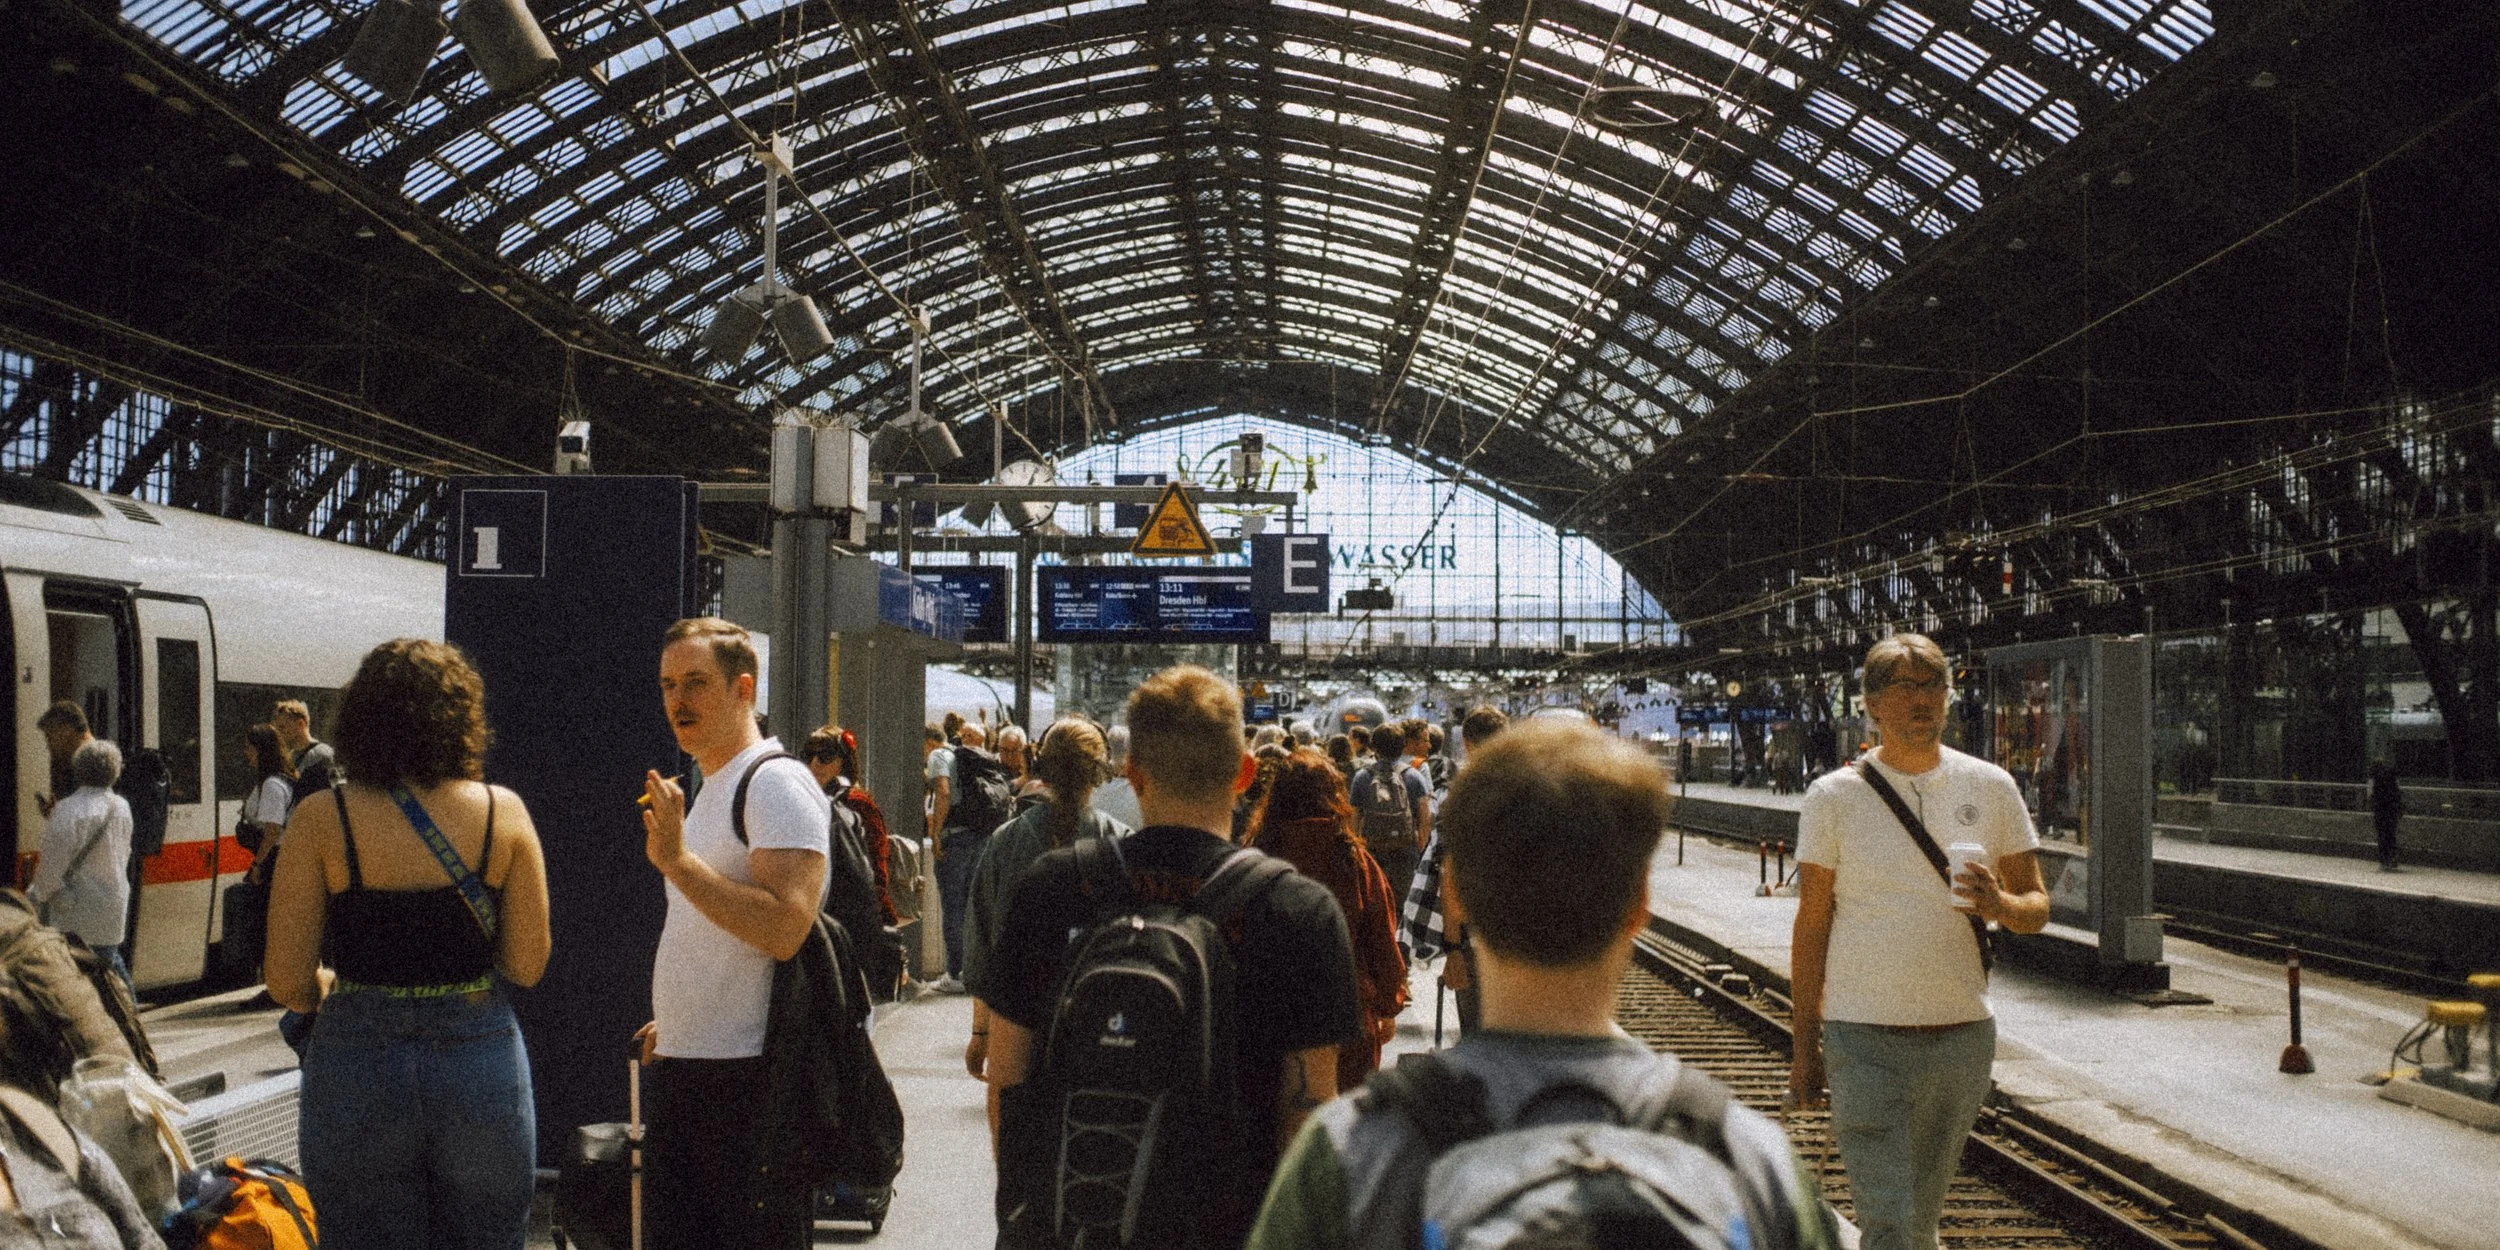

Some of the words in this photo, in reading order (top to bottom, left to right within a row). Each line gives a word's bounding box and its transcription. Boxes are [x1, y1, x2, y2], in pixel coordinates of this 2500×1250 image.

[1206, 458, 1280, 492] 41
[472, 526, 502, 569] 1
[1328, 544, 1457, 569] WASSER
[1283, 537, 1318, 593] E
[1159, 583, 1183, 593] 13:11
[1159, 595, 1191, 605] Dresden
[1192, 595, 1208, 605] Hbf
[1279, 692, 1290, 707] D
